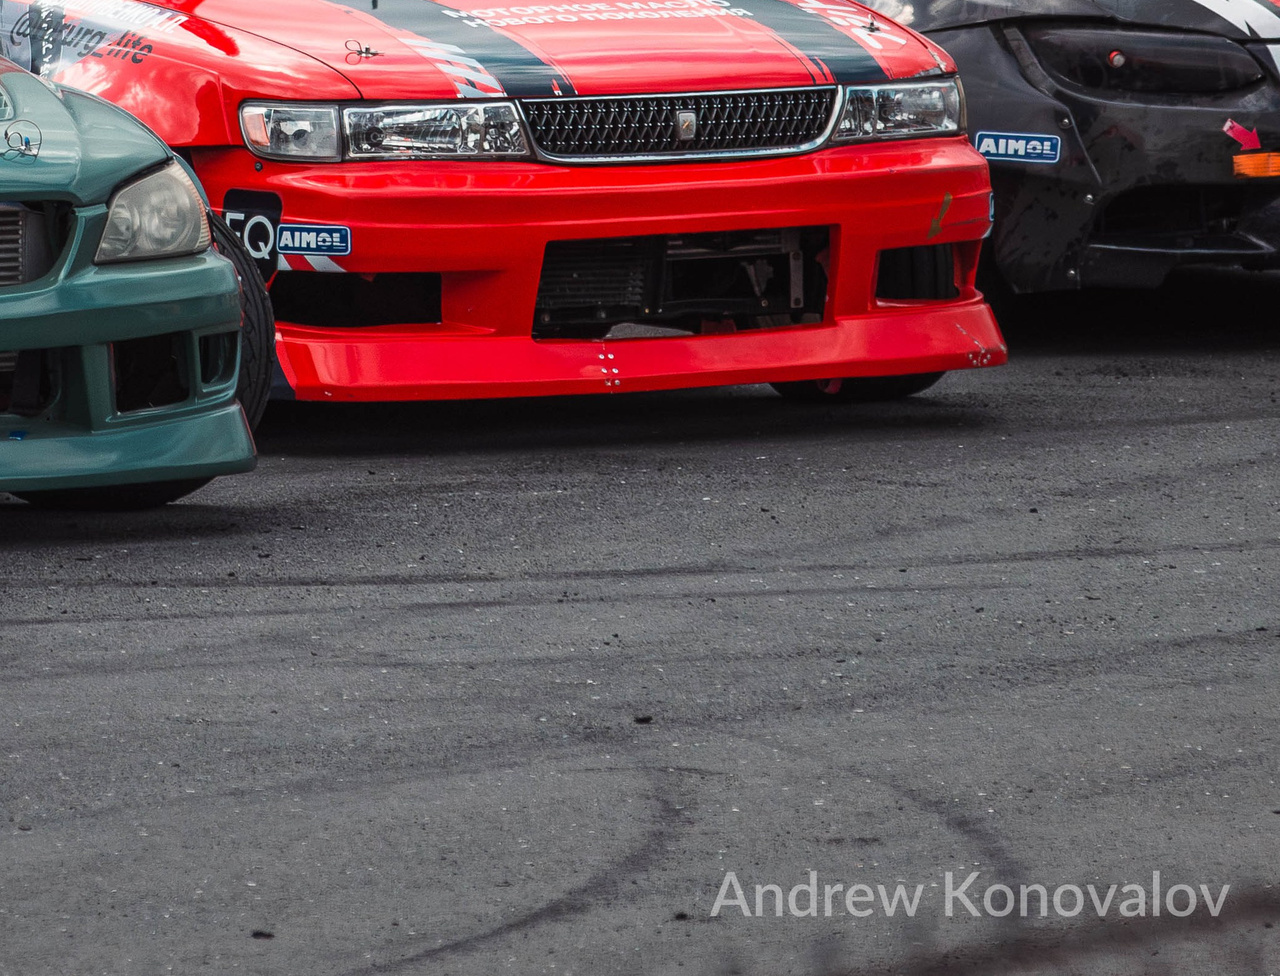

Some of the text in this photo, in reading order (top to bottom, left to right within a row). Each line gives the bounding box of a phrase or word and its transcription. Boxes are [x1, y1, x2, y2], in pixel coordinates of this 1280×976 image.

[441, 1, 615, 20] МОТОРНОЕ
[463, 5, 754, 29] НОВОГО ПОКОЛЕНИЯ
[979, 138, 1056, 157] AIMOL
[279, 230, 346, 249] AIMOL
